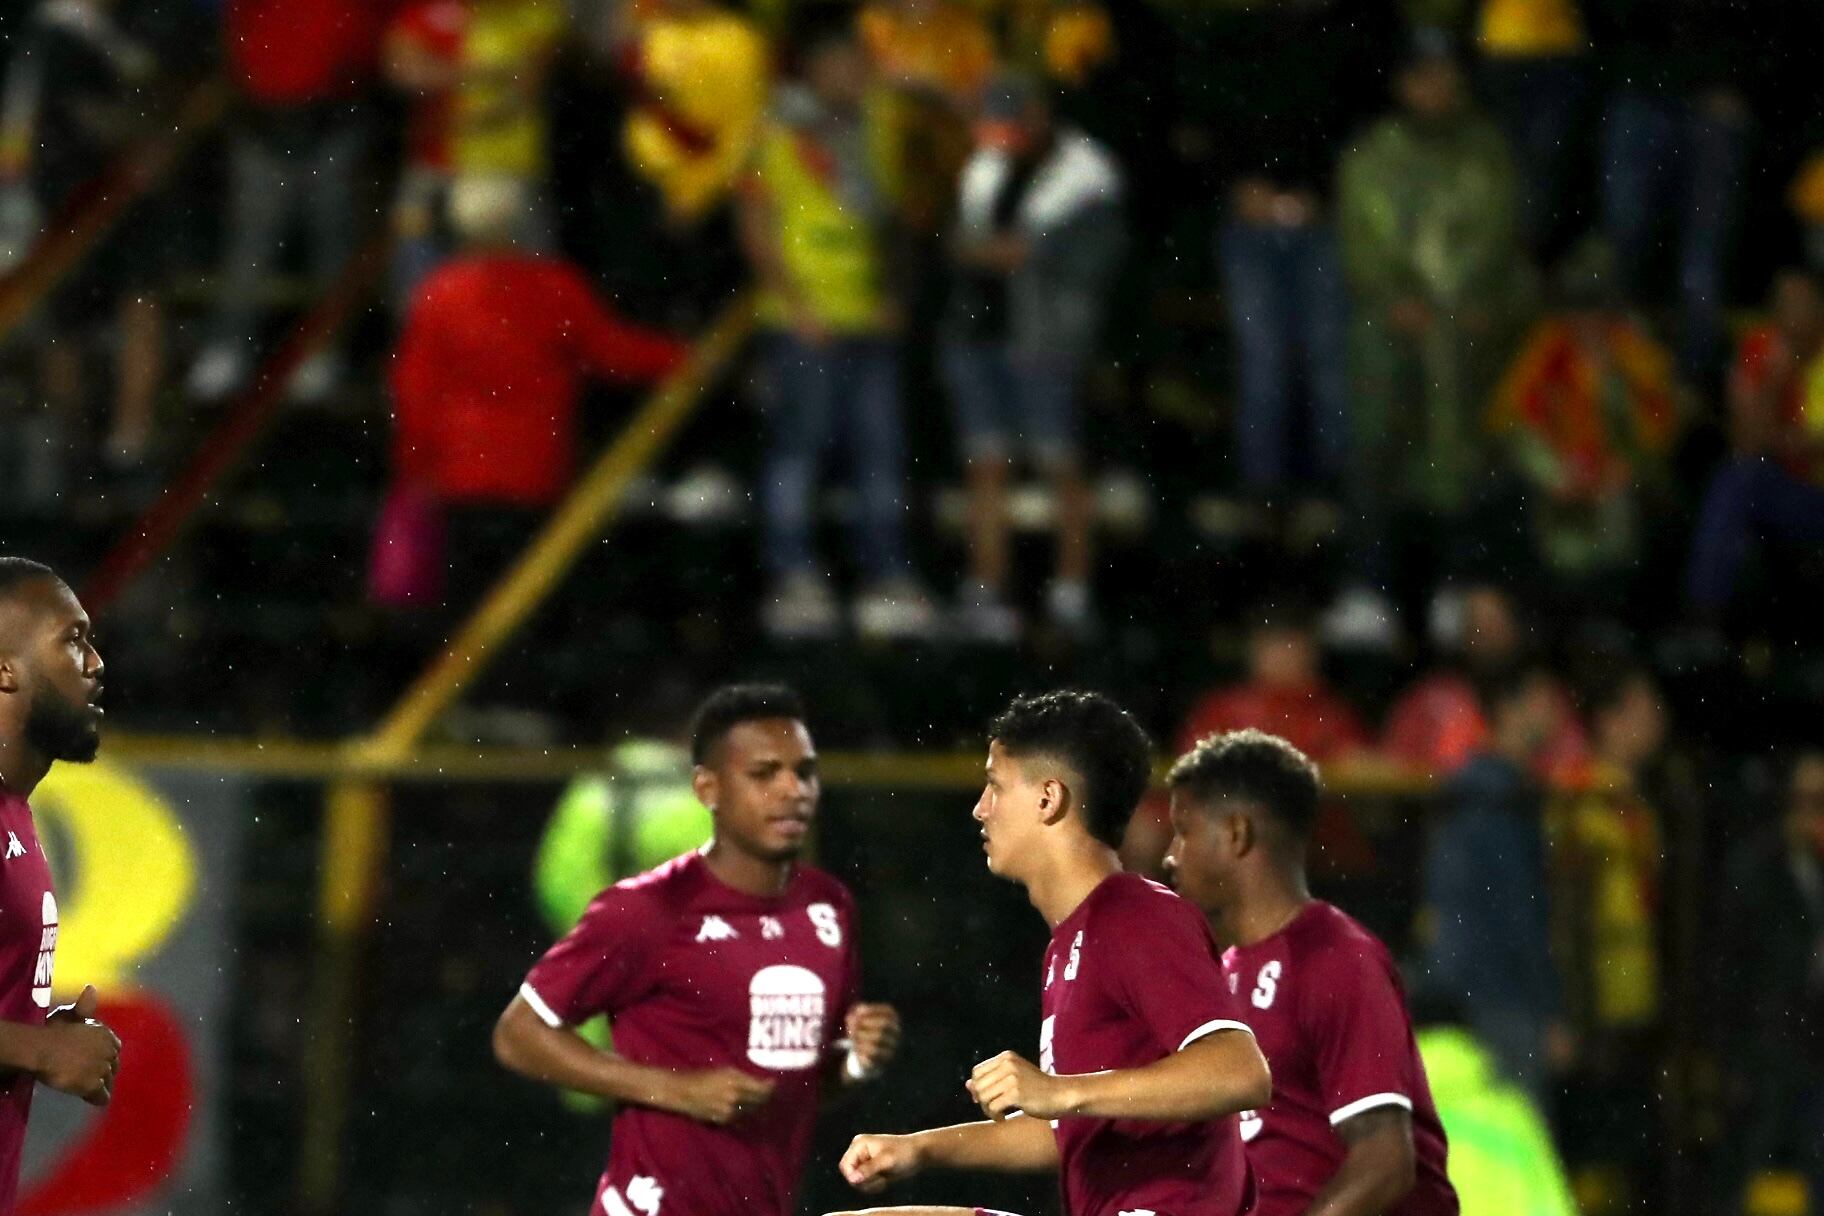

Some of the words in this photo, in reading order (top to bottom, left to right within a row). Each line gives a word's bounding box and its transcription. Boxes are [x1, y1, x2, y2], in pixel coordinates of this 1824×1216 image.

[807, 903, 841, 947] S
[1251, 960, 1281, 1010] S
[749, 1016, 822, 1048] KING
